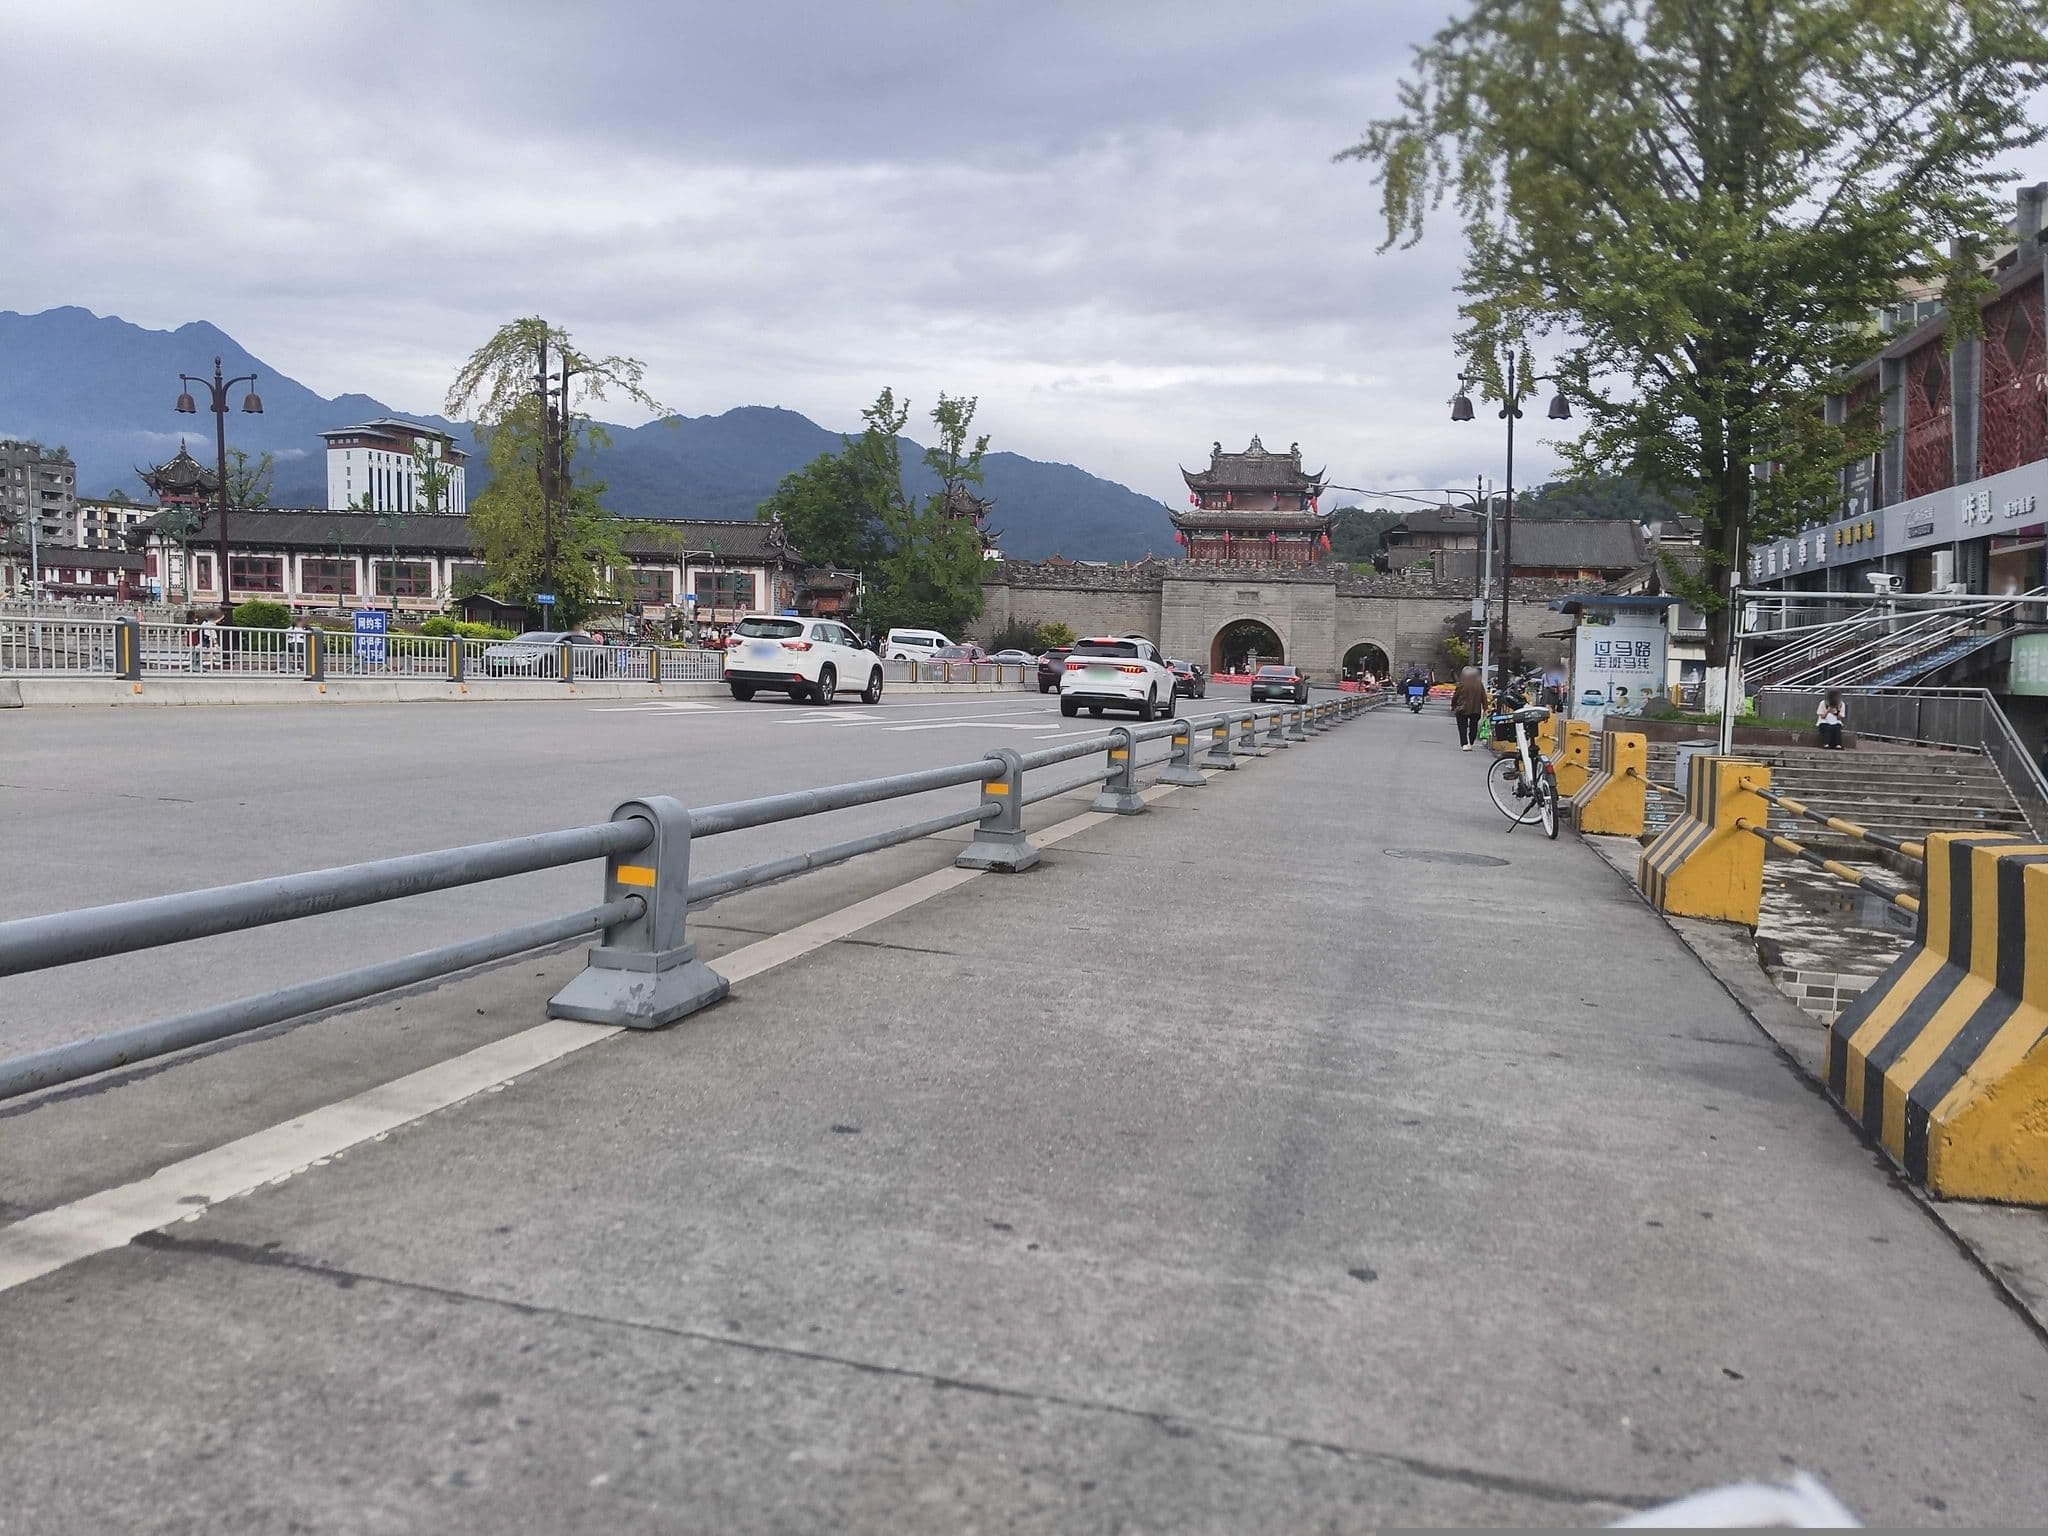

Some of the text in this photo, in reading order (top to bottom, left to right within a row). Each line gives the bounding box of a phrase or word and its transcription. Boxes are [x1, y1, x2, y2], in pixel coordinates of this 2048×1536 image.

[358, 617, 382, 630] 网约车
[1594, 640, 1651, 657] 过马路
[1594, 657, 1649, 670] 走斑马线
